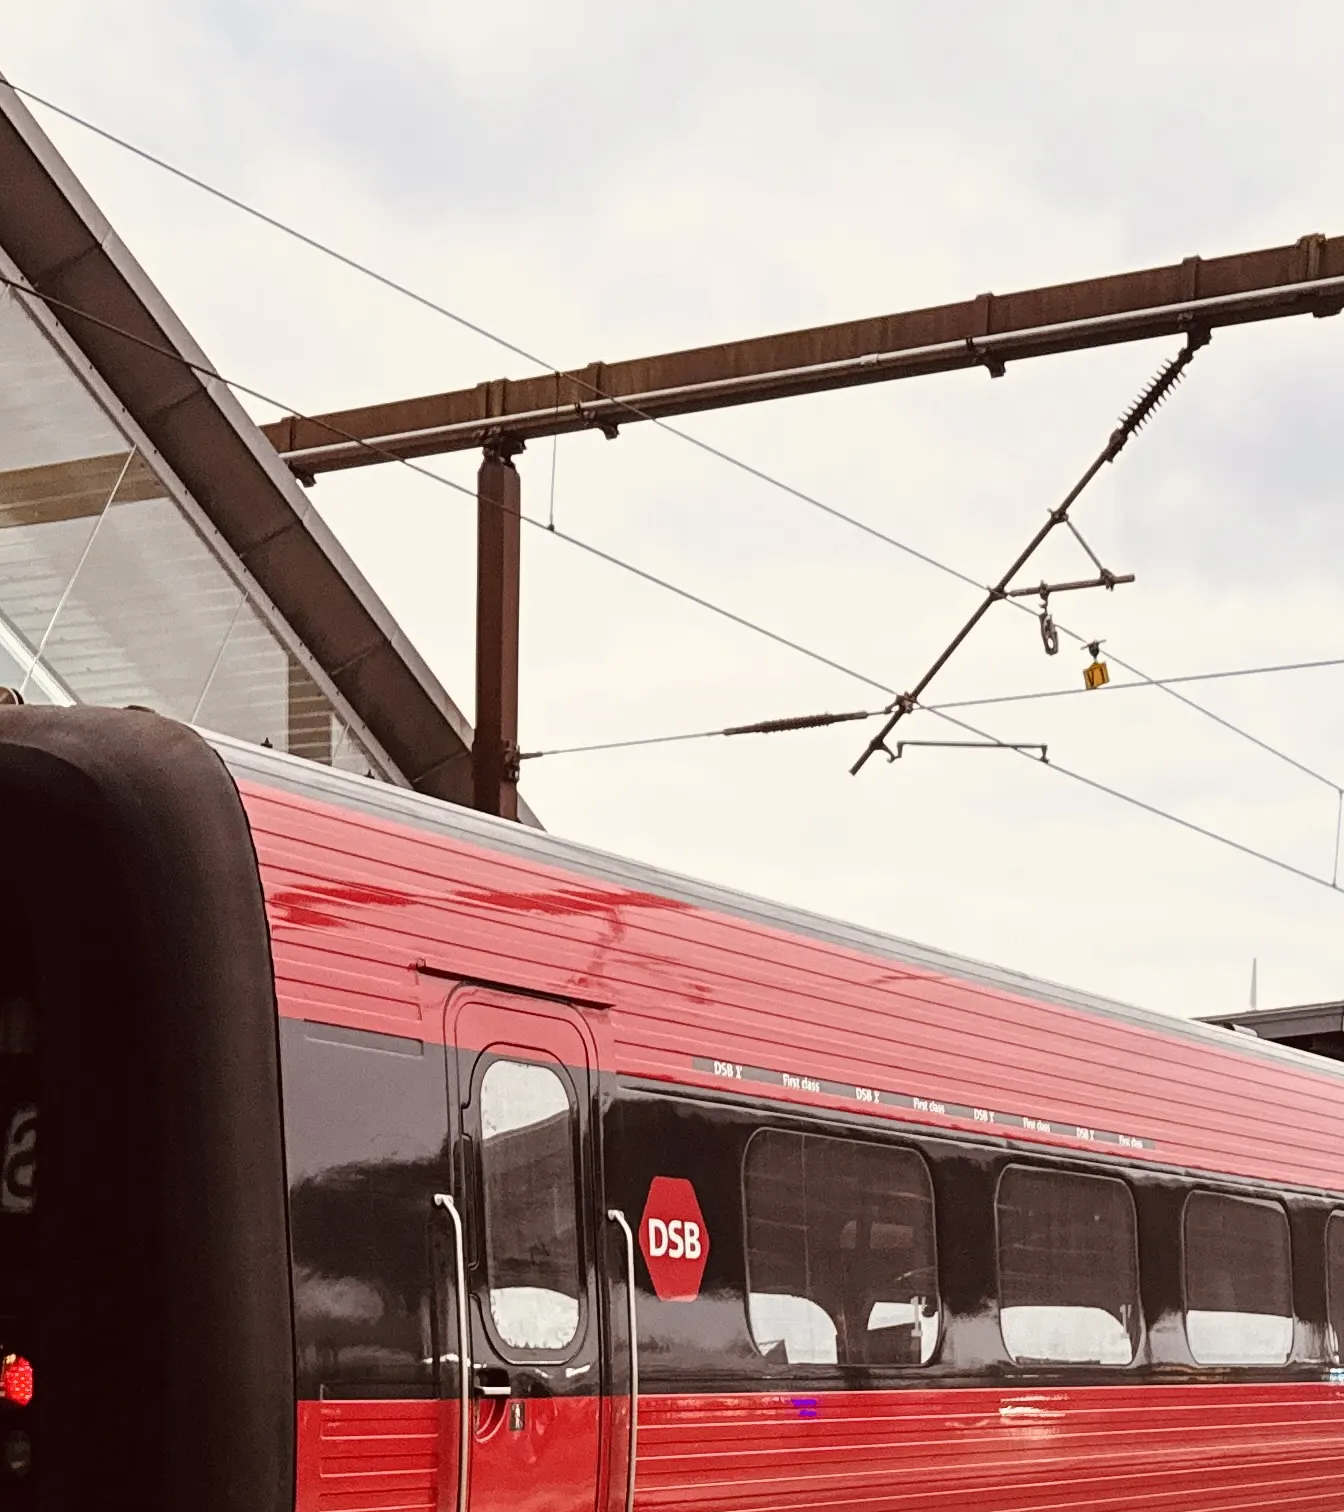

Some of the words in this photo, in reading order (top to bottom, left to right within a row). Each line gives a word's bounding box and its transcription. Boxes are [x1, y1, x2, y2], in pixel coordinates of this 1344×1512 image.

[713, 1061, 734, 1078] DSB
[782, 1073, 800, 1089] First
[802, 1077, 820, 1093] class
[855, 1087, 872, 1101] DSB
[913, 1097, 928, 1112] First
[929, 1100, 945, 1115] class
[973, 1108, 988, 1122] DSB
[648, 1217, 702, 1260] DSB
